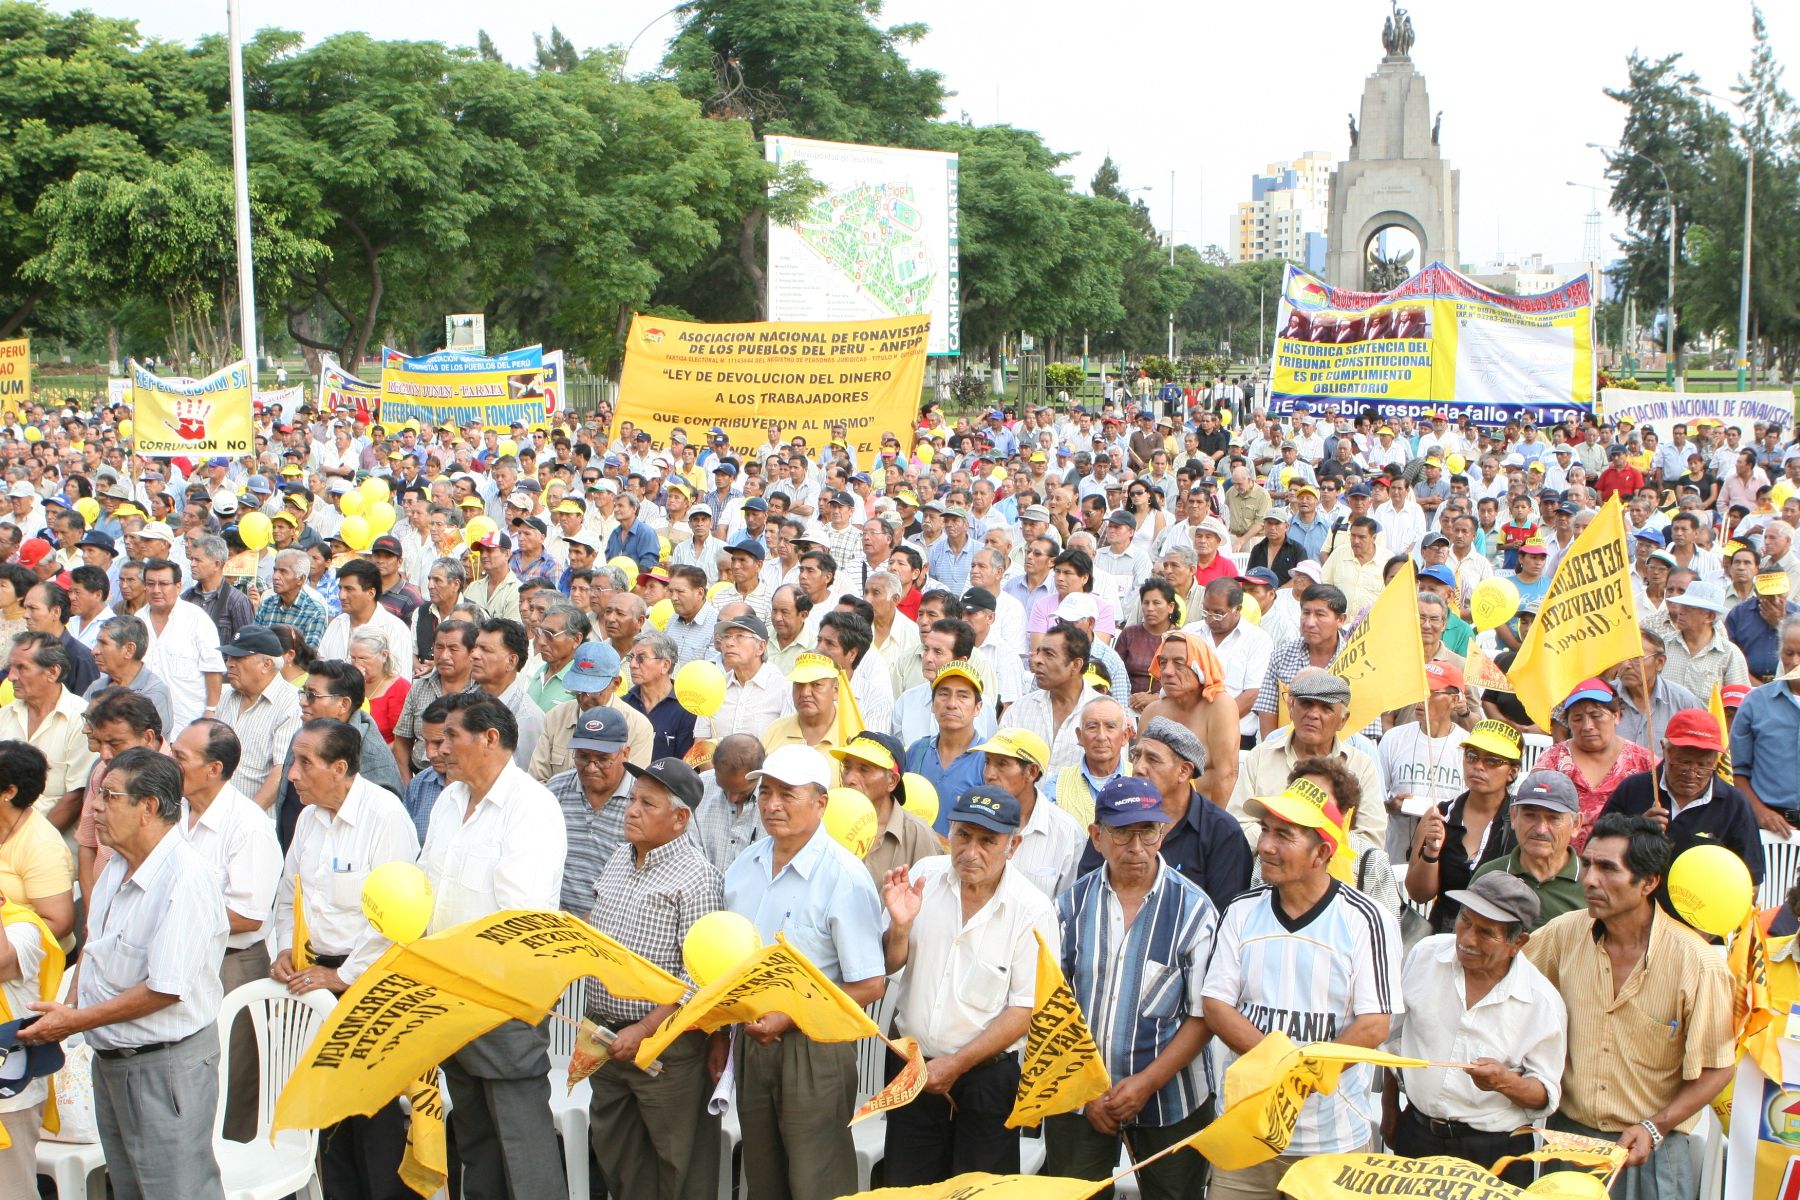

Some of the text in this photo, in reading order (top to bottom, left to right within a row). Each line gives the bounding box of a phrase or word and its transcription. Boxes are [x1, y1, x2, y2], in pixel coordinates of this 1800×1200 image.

[948, 168, 960, 351] CAMPO DE MARTE
[1551, 291, 1566, 310] DEL
[679, 322, 931, 344] ASOCIACION NACIONAL DE FONAVISTAS
[689, 344, 705, 354] DE
[709, 345, 734, 355] LOS
[738, 345, 797, 355] PUEBLOS
[802, 346, 829, 355] DEL
[830, 344, 865, 355] PERU
[879, 336, 922, 353] ANFPP
[1283, 341, 1428, 357] HISTORICA SENTENCIA DEL
[450, 363, 463, 371] LOS
[464, 362, 496, 371] PUEBLOS
[497, 360, 510, 369] DEL
[1278, 355, 1432, 370] TRIBUNAL CONSTITUCIONAL
[231, 368, 247, 389] SI
[696, 371, 713, 382] DE
[717, 372, 805, 384] DEVOLUCION
[809, 374, 834, 384] DEL
[839, 370, 892, 384] DINERO
[1293, 369, 1412, 382] ES DE CUMPLIMIENTO
[460, 384, 505, 398] TARMA
[1313, 383, 1388, 394] OBLIGATORIO
[715, 391, 869, 404] A LOS TRABAJADORES
[435, 406, 482, 427] NACIONAL
[485, 402, 545, 426] FONAVISTA
[1466, 405, 1506, 422] fallo
[1671, 400, 1721, 416] NACIONAL
[1723, 400, 1735, 416] DE
[653, 412, 680, 424] QUE
[684, 416, 797, 430] CONTRIBUYERON
[802, 419, 819, 430] AL
[140, 440, 247, 451] CORRUPCION NO
[857, 442, 873, 453] EL
